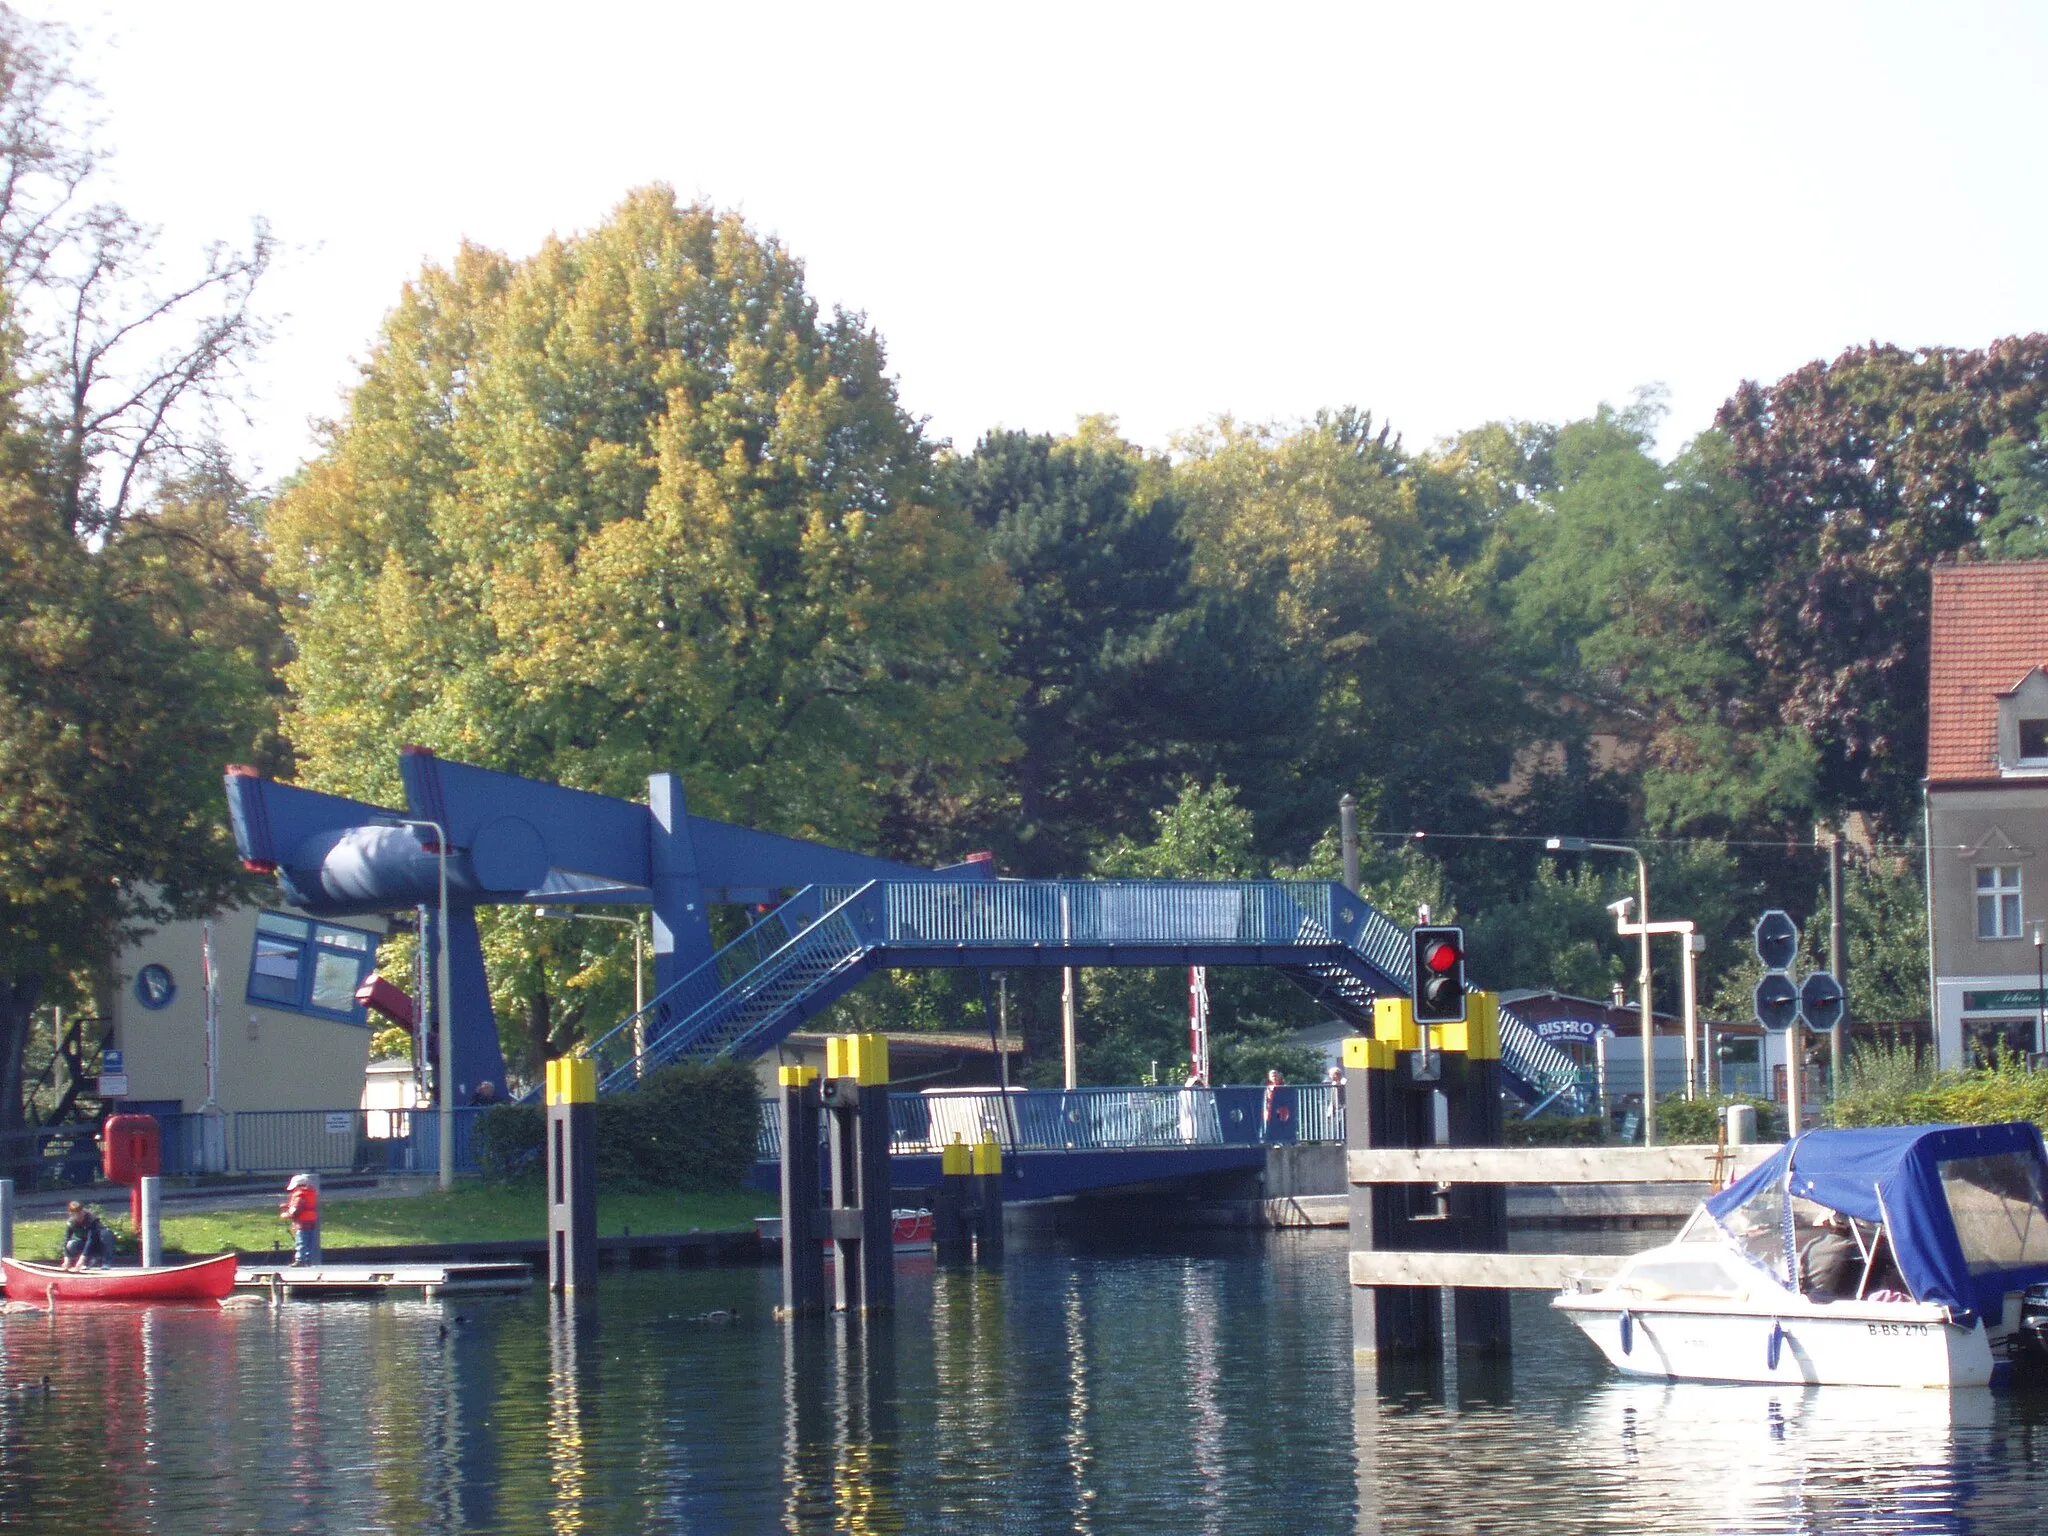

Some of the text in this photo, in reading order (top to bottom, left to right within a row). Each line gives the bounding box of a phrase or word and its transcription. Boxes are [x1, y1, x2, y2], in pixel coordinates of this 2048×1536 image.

[1538, 1020, 1595, 1036] BISTRO
[1868, 1324, 1928, 1337] B-BS 270
